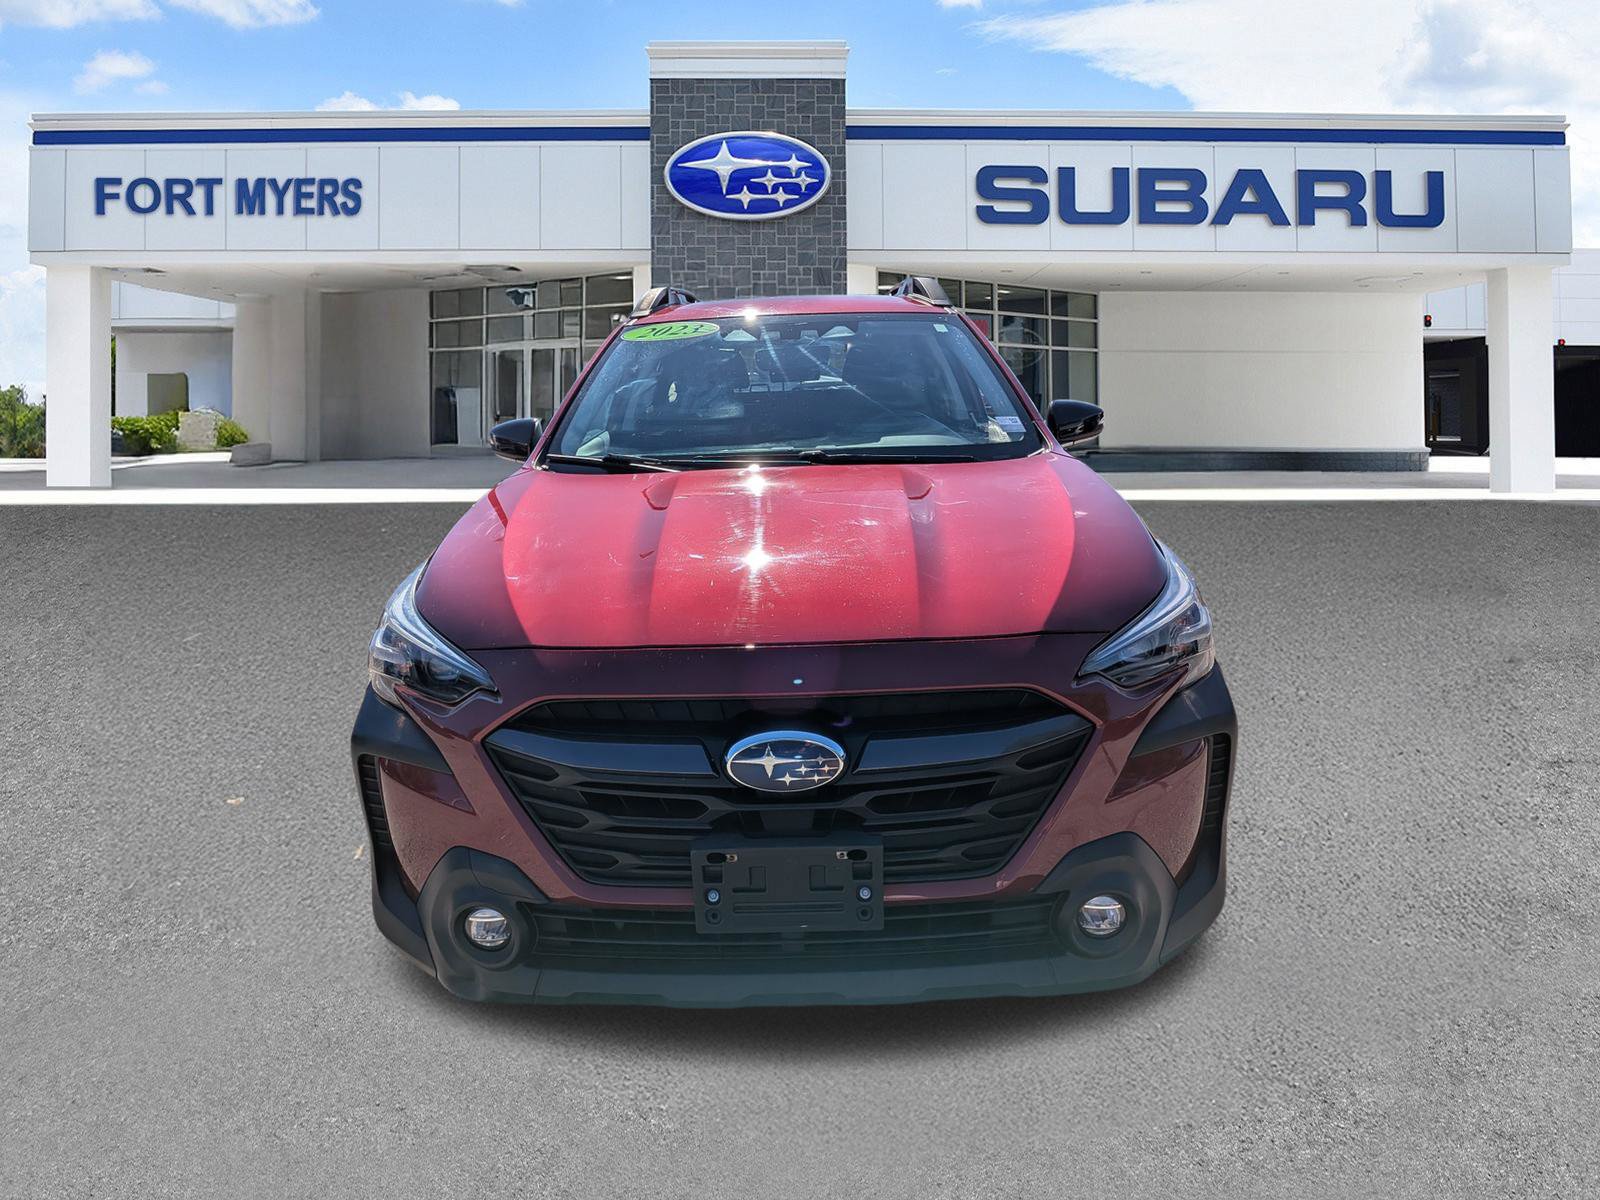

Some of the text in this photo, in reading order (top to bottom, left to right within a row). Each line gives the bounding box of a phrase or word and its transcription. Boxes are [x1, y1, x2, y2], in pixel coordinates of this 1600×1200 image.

[94, 177, 363, 216] FORT MYERS
[975, 164, 1445, 229] SUBARU
[635, 324, 705, 339] 2023
